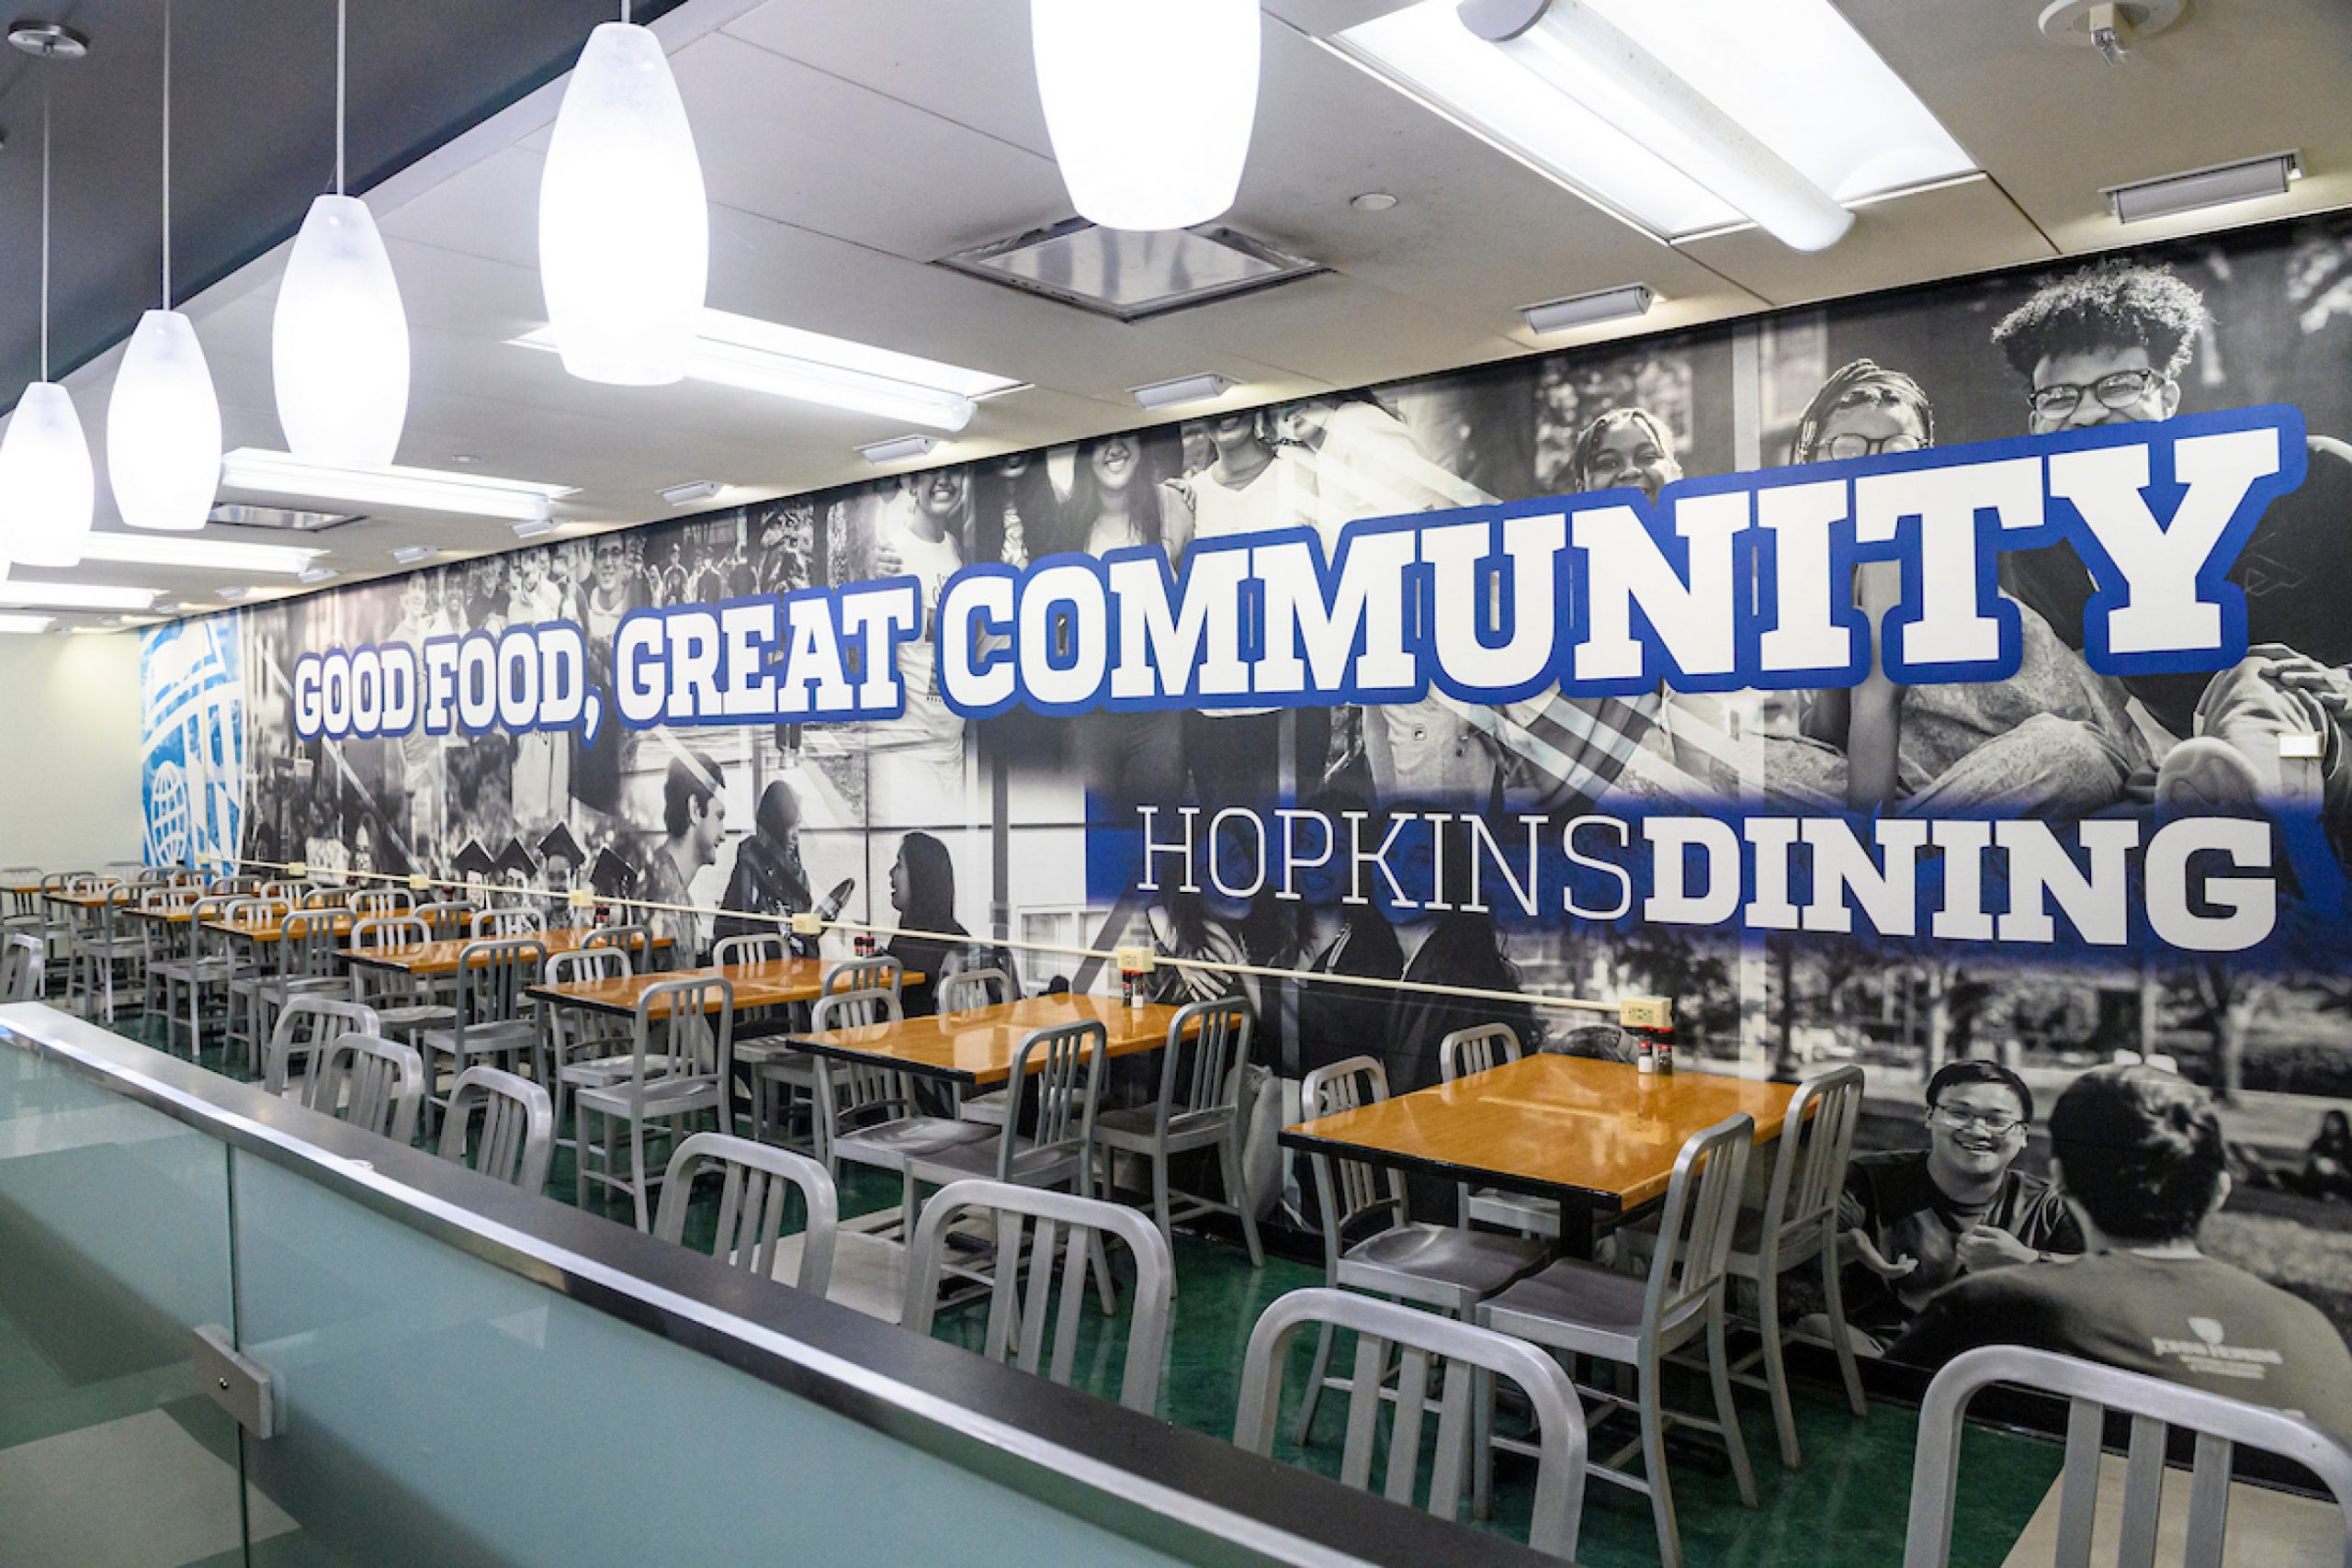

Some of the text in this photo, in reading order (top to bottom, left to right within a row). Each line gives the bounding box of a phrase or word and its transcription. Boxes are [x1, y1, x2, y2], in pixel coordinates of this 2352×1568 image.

[294, 426, 2281, 741] GOOD FOOD, GREAT COMMUNITY
